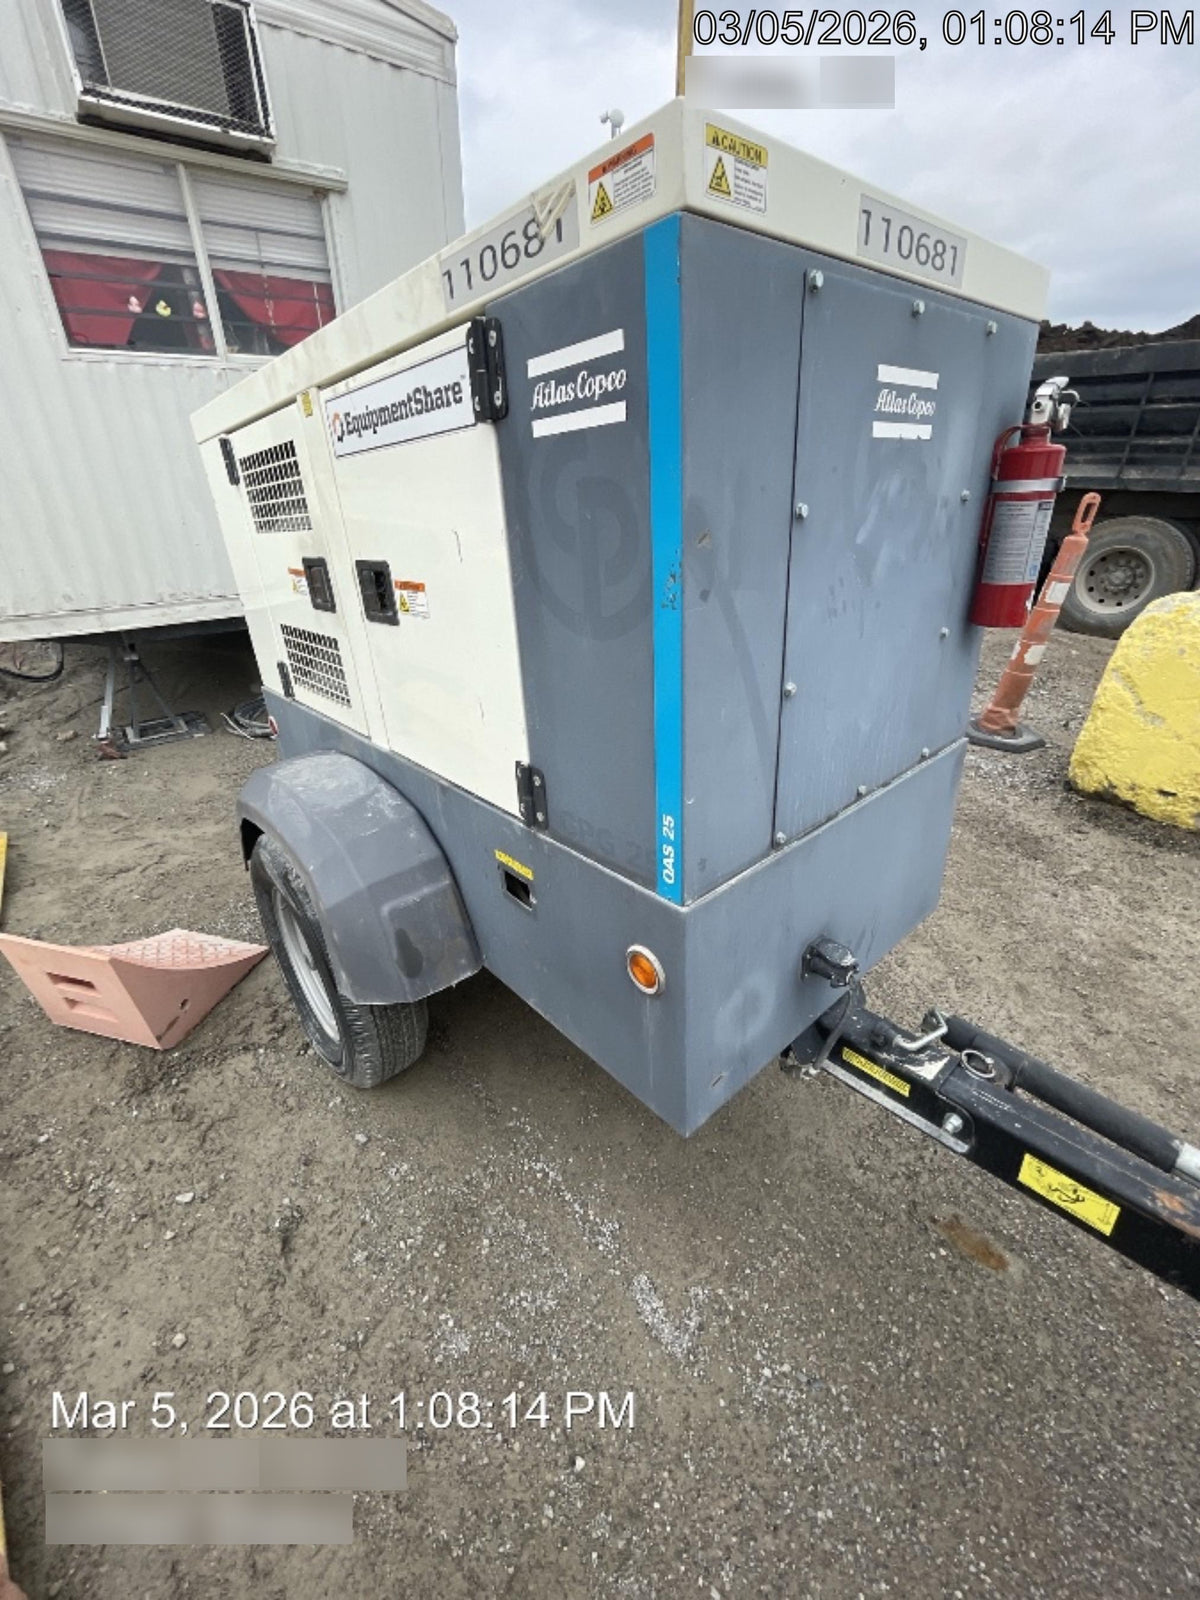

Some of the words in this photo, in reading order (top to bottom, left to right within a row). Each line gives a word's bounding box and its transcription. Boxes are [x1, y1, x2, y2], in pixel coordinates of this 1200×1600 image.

[862, 209, 957, 276] 110681
[344, 380, 463, 438] EquipmentShare
[662, 813, 675, 841] 25
